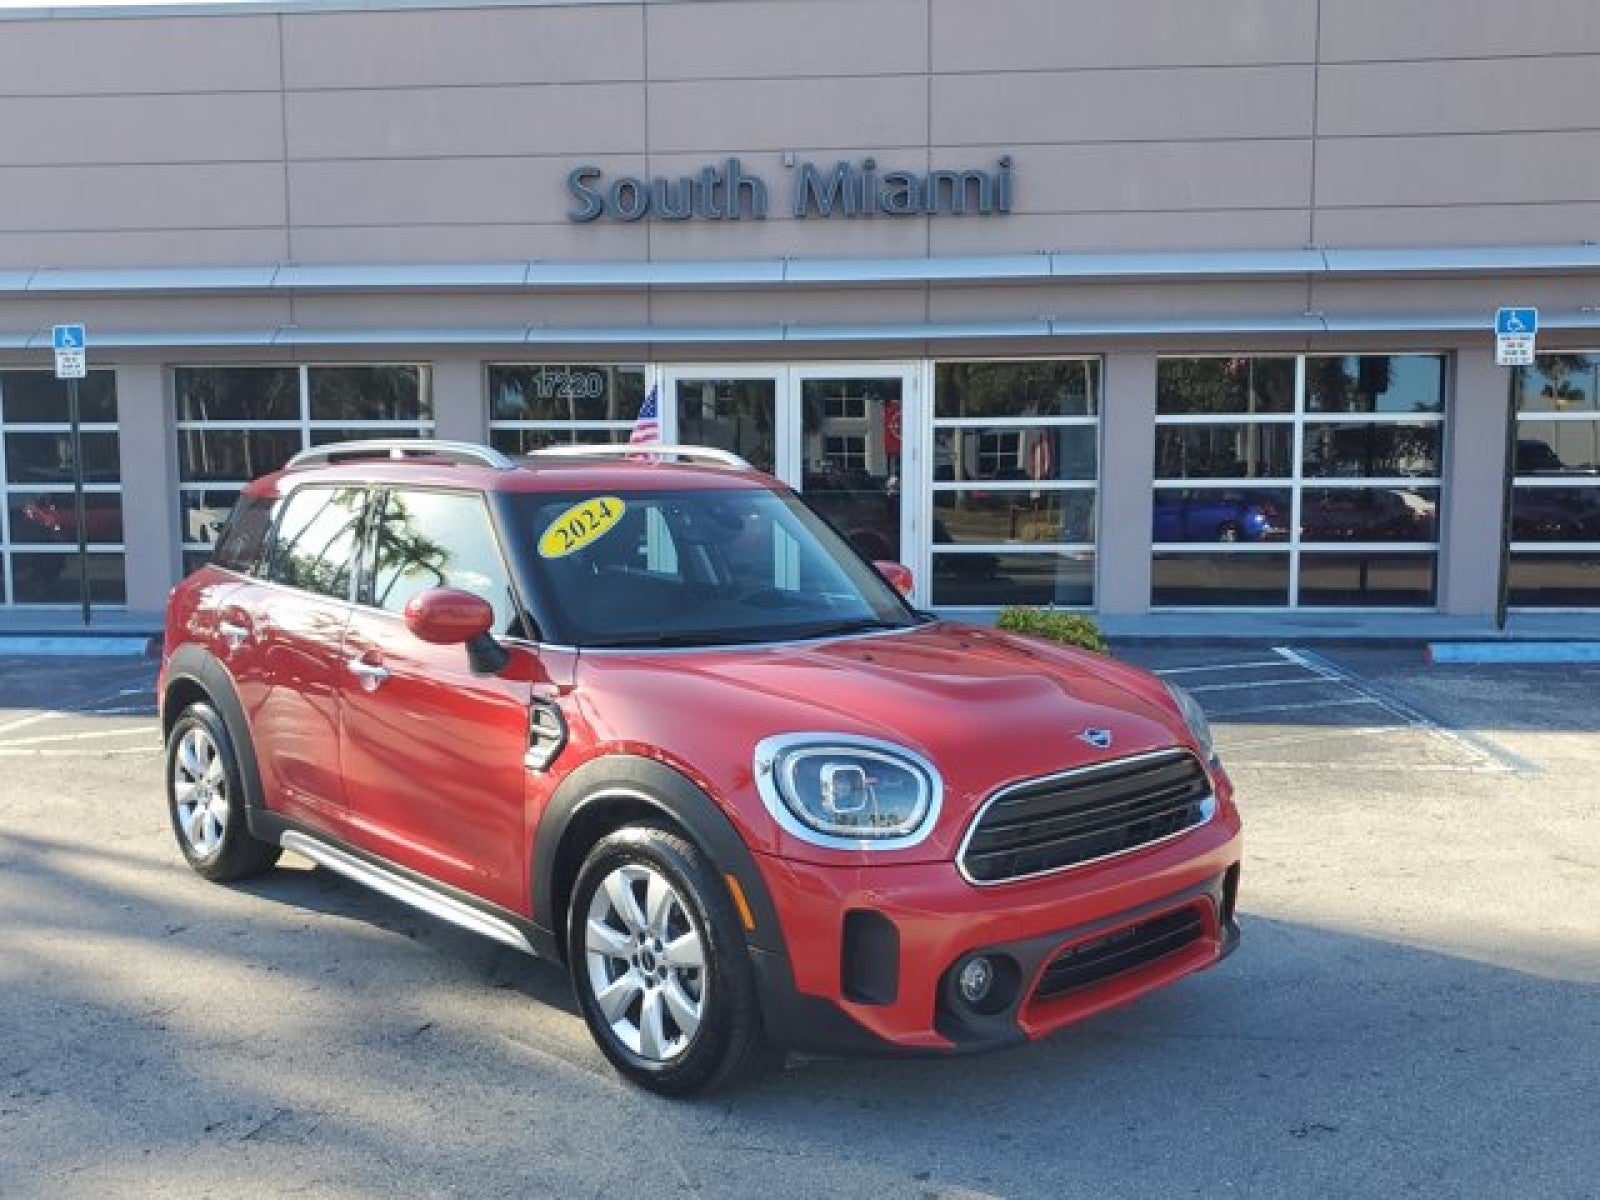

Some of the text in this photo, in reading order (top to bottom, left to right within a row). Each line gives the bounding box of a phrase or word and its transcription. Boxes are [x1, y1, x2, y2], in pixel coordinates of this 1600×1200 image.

[568, 155, 1014, 221] South Miami
[555, 499, 613, 550] 2024
